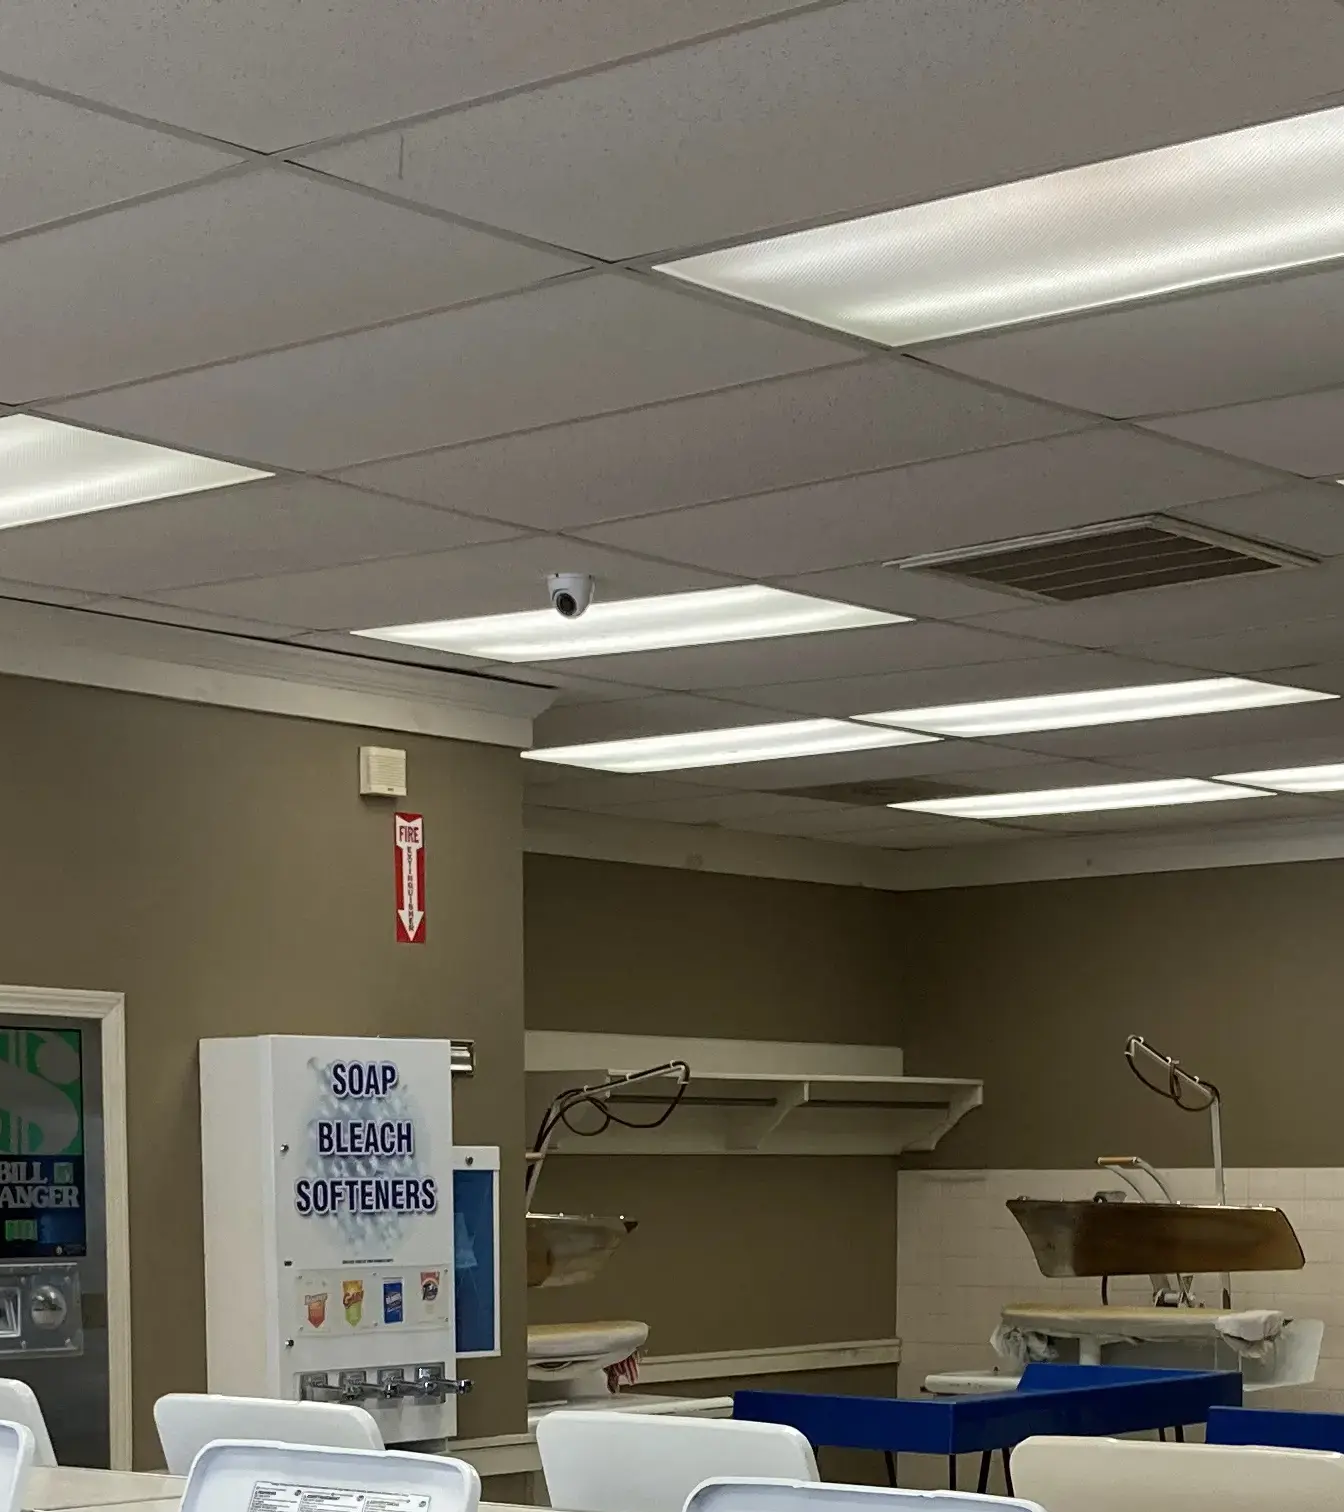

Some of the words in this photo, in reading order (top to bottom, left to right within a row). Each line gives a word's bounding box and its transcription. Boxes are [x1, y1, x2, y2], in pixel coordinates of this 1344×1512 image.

[399, 826, 419, 843] FIRE
[407, 846, 415, 931] EXTINGUISHER
[332, 1062, 397, 1097] SOAP
[318, 1122, 413, 1156] BLEACH
[295, 1179, 437, 1214] SOFTENERS
